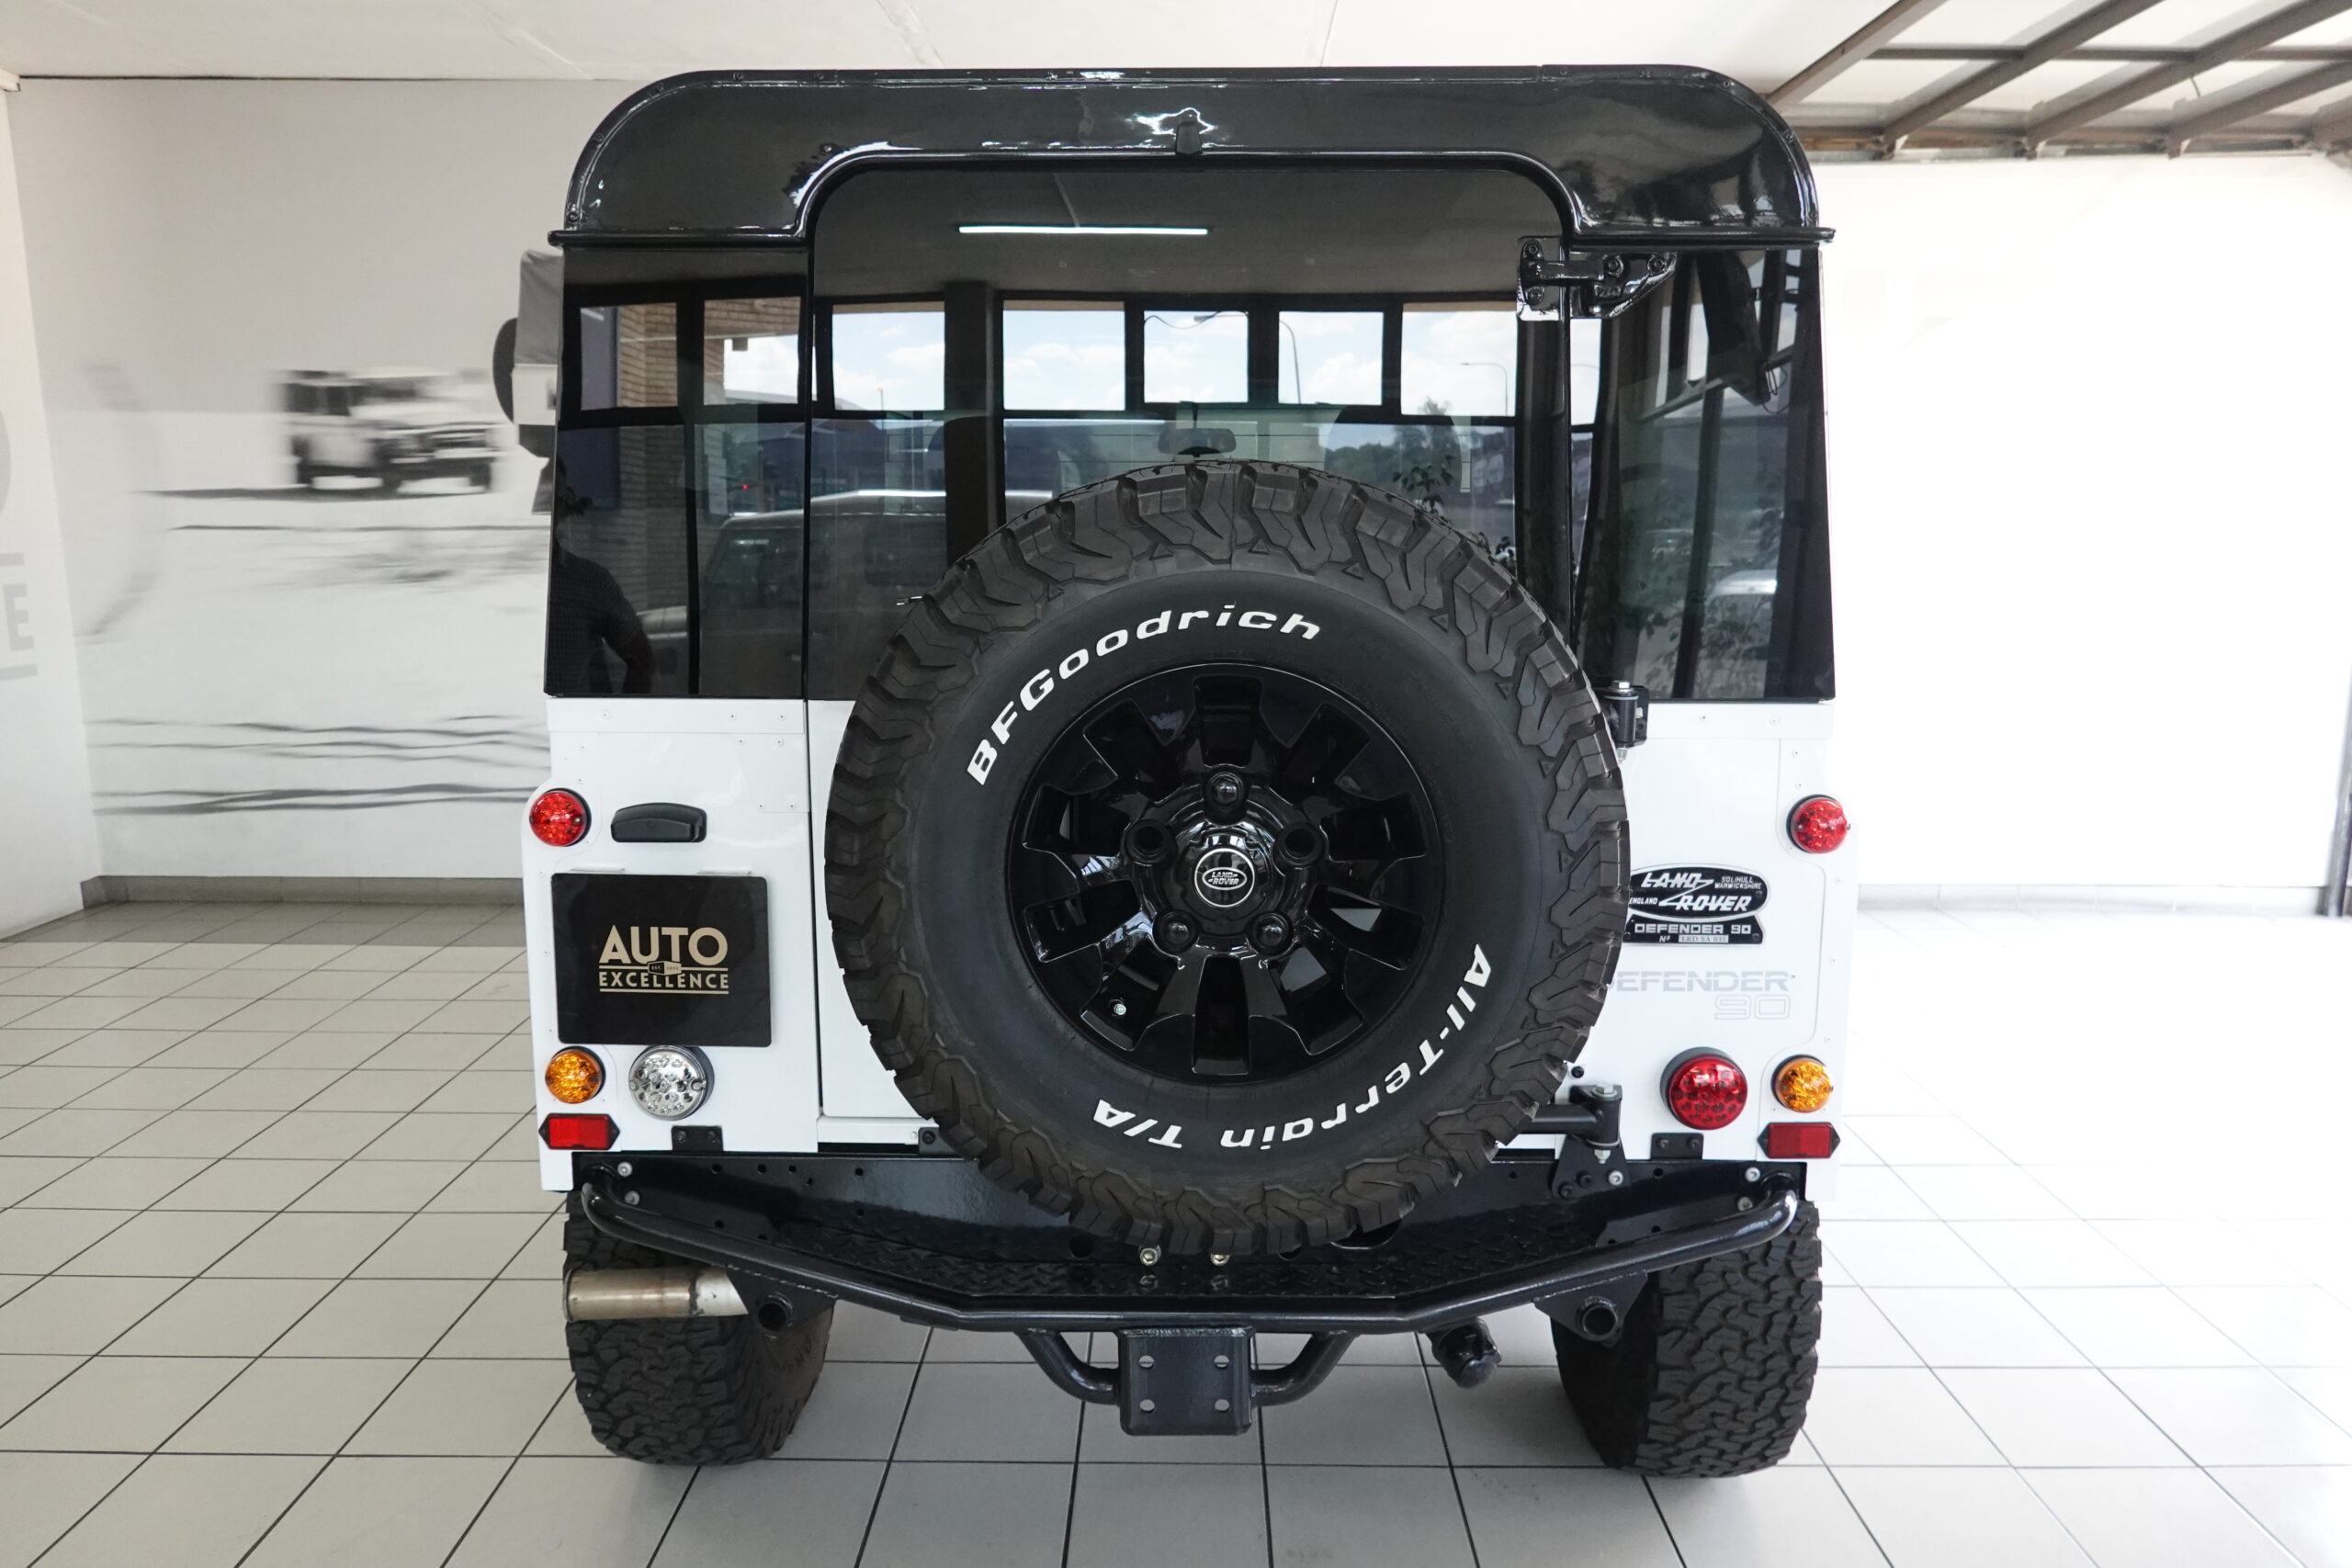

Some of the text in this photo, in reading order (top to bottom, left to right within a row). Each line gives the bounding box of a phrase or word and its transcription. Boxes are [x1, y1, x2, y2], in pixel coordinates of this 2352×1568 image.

[967, 604, 1320, 785] BFGoodrich
[1212, 877, 1239, 886] ROVER
[1640, 872, 1709, 889] LAND
[1714, 882, 1762, 890] WARWICKSHIRE
[1721, 875, 1754, 884] SOLIHULL
[1629, 897, 1658, 906] ENGLAND
[1674, 895, 1752, 912] ROVER
[1634, 923, 1752, 935] DEFENDER 90
[598, 924, 729, 966] AUTO
[598, 971, 729, 989] EXCELLENCE
[1608, 970, 1790, 992] EFENDER
[1714, 993, 1792, 1021] 90
[1092, 1099, 1182, 1149] T/A
